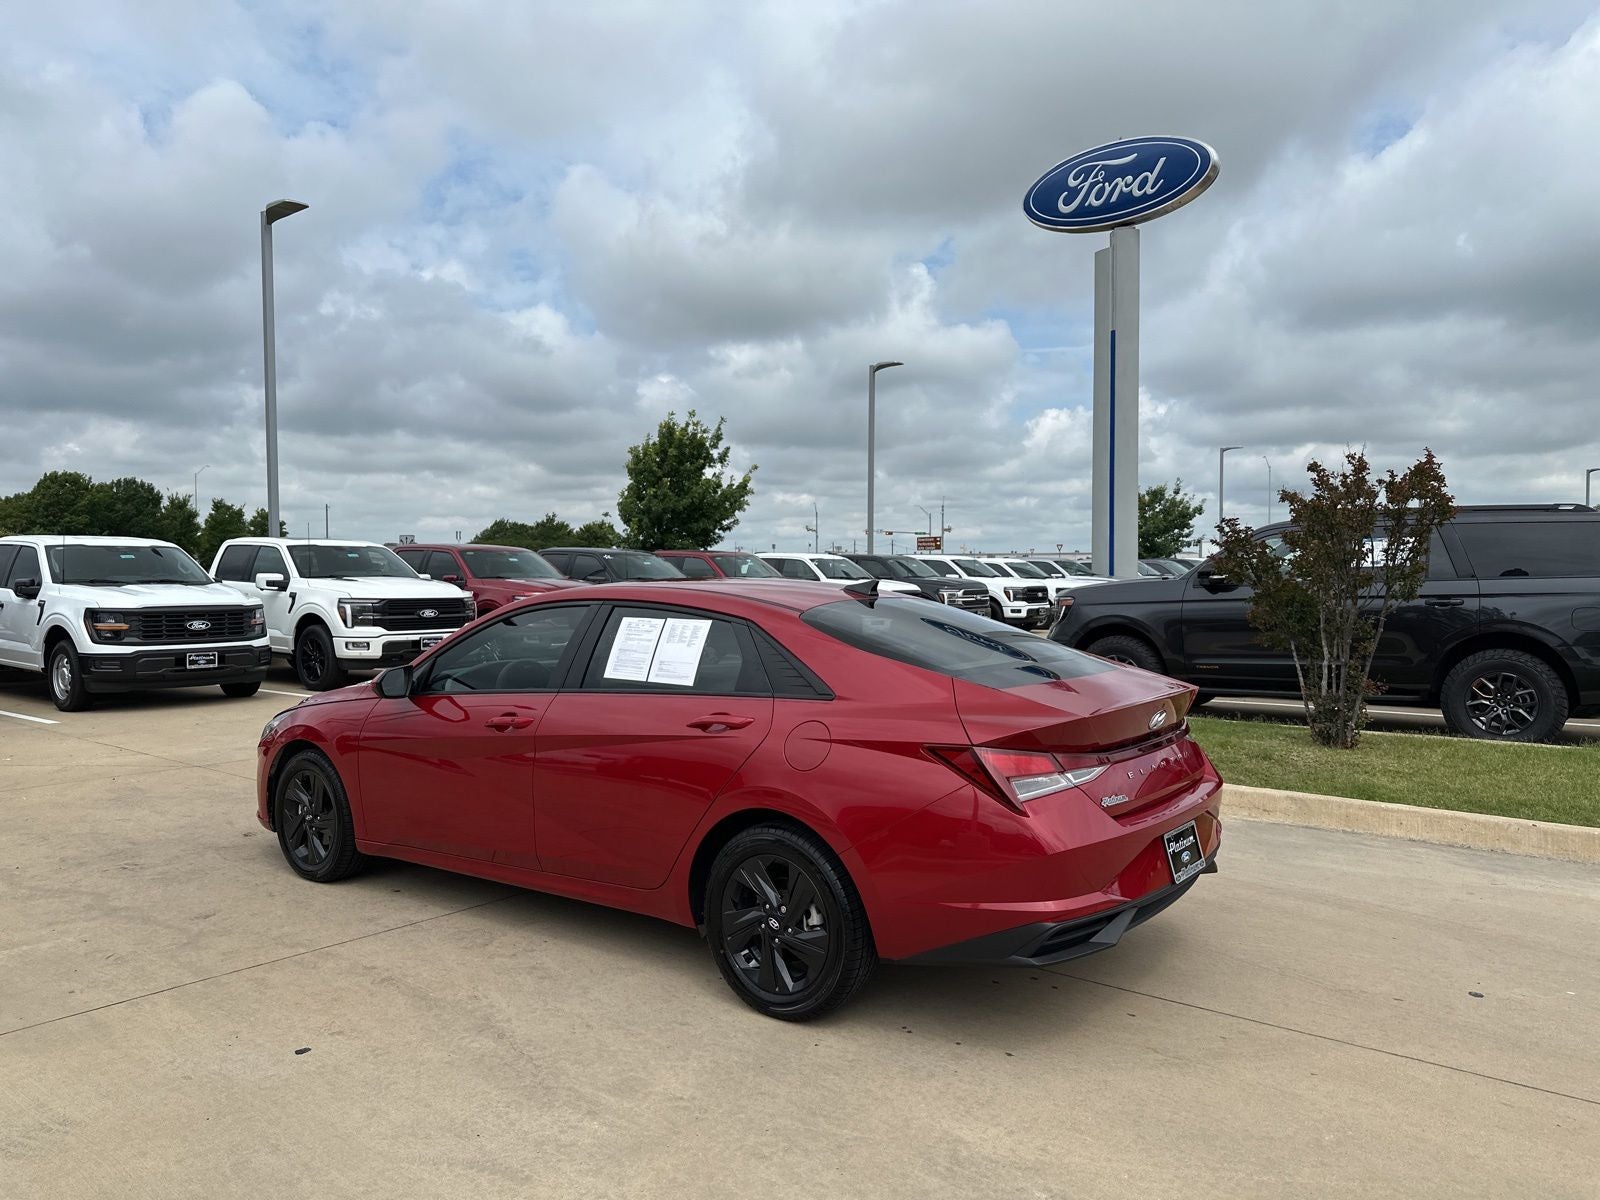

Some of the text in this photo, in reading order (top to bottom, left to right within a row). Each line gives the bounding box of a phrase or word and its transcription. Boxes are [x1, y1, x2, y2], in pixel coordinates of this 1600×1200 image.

[1057, 152, 1167, 214] Ford
[190, 621, 208, 630] Ford
[1101, 794, 1128, 808] Platinum
[1168, 835, 1196, 855] Platinum
